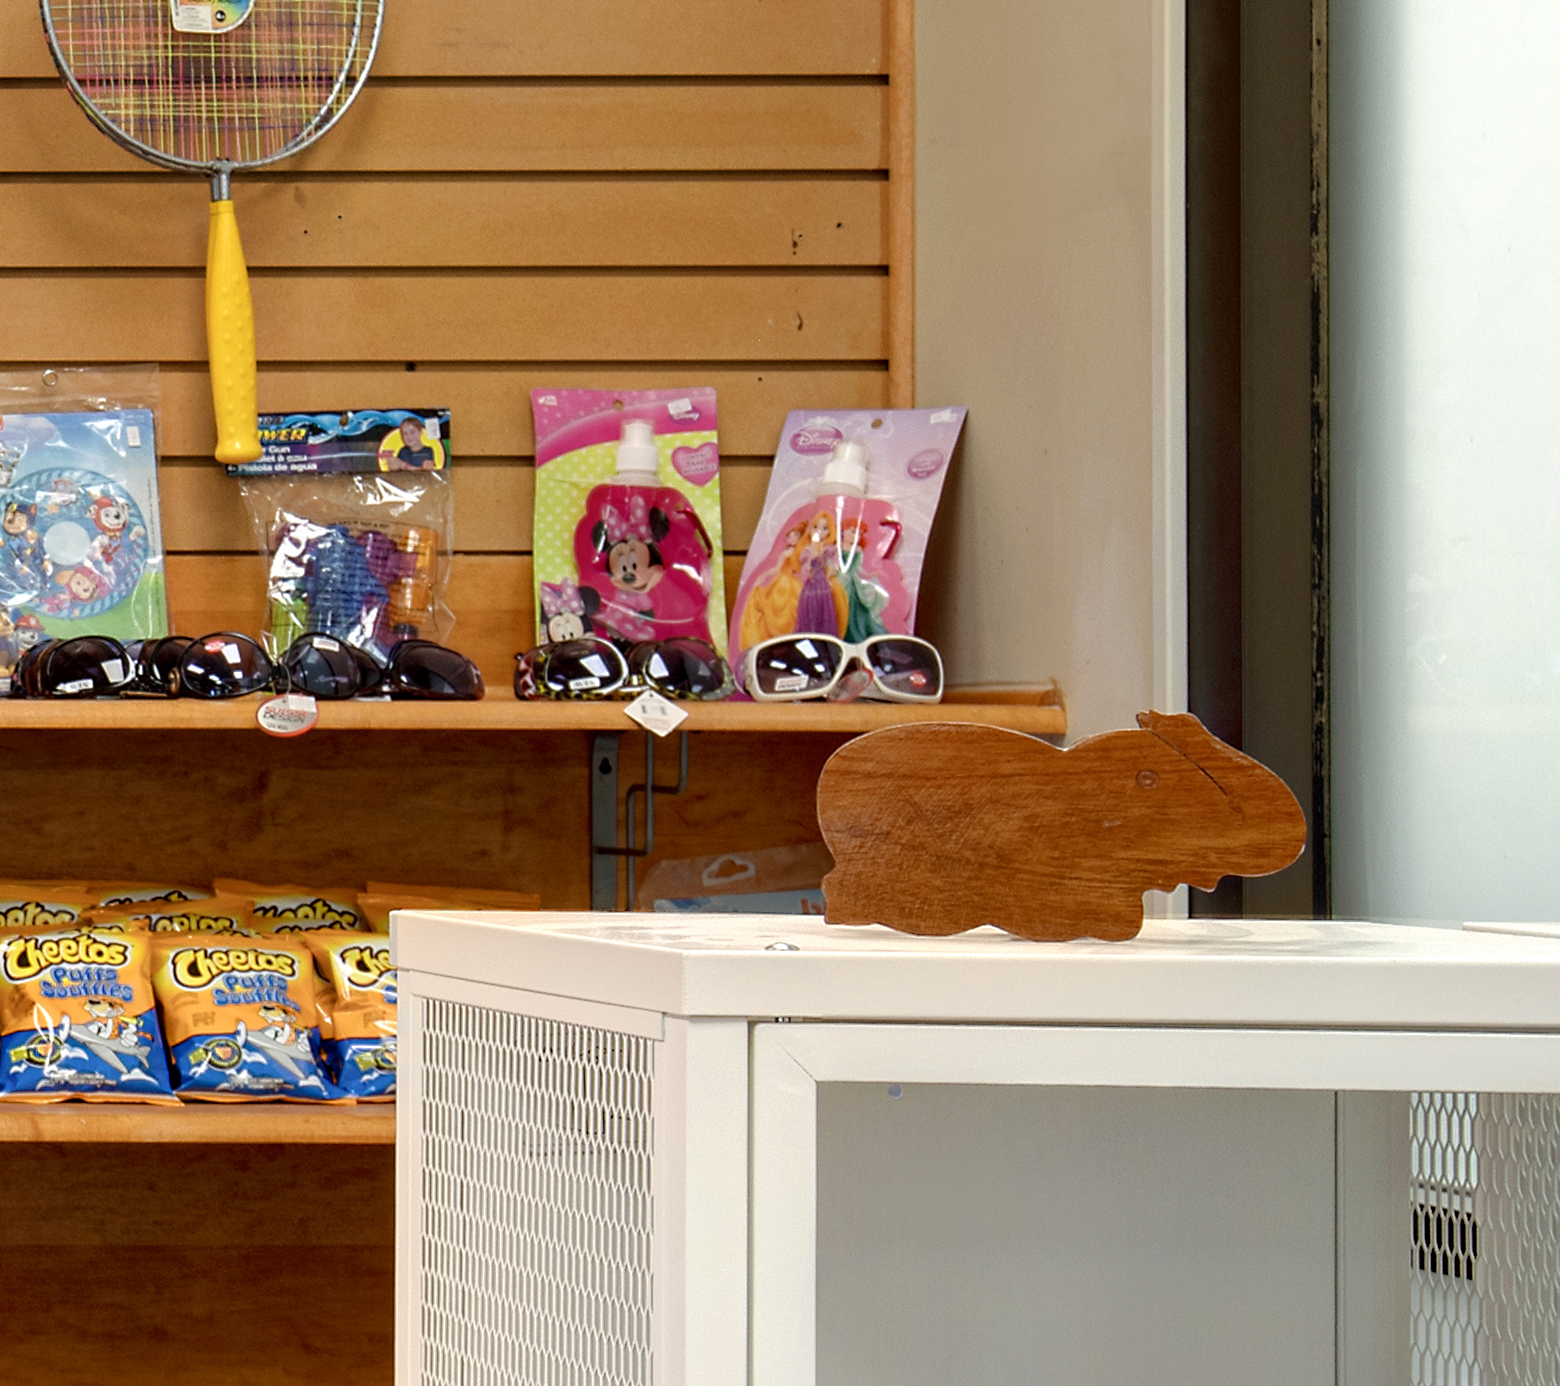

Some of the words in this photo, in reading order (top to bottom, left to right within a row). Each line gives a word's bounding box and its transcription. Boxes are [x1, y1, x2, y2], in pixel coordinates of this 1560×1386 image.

[269, 445, 291, 454] Gun
[237, 463, 273, 472] Pistola
[290, 464, 318, 473] agua
[4, 932, 128, 982] Cheetos
[171, 946, 297, 988] Cheetos
[52, 968, 119, 985] Puffs
[224, 974, 288, 992] Puffs
